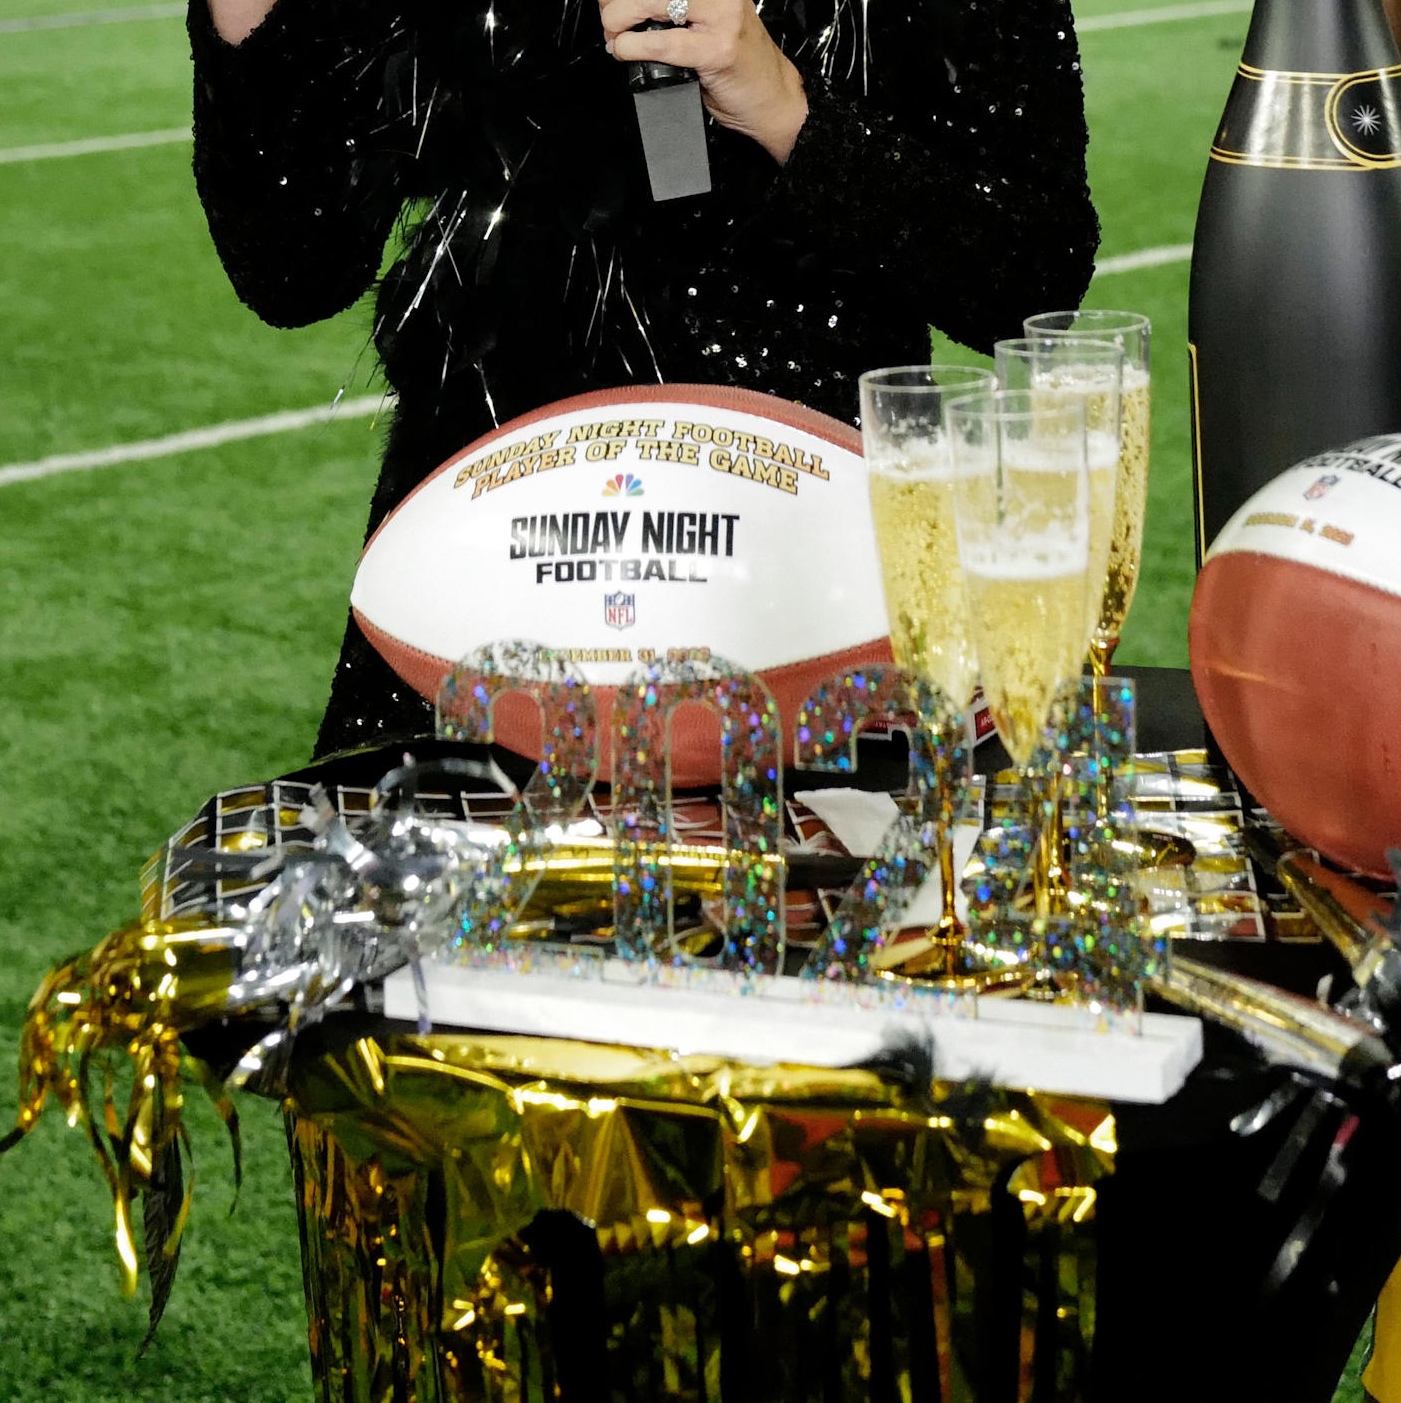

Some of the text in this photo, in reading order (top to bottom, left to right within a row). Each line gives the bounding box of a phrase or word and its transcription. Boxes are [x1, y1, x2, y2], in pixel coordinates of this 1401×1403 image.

[454, 420, 830, 488] SUNDAY NIGHT FOOTBALL
[471, 440, 798, 500] PLAYER OF THE GAME
[510, 511, 740, 559] SUNDAY NIGHT
[536, 559, 708, 584] FOOTBALL
[608, 606, 633, 625] NFL
